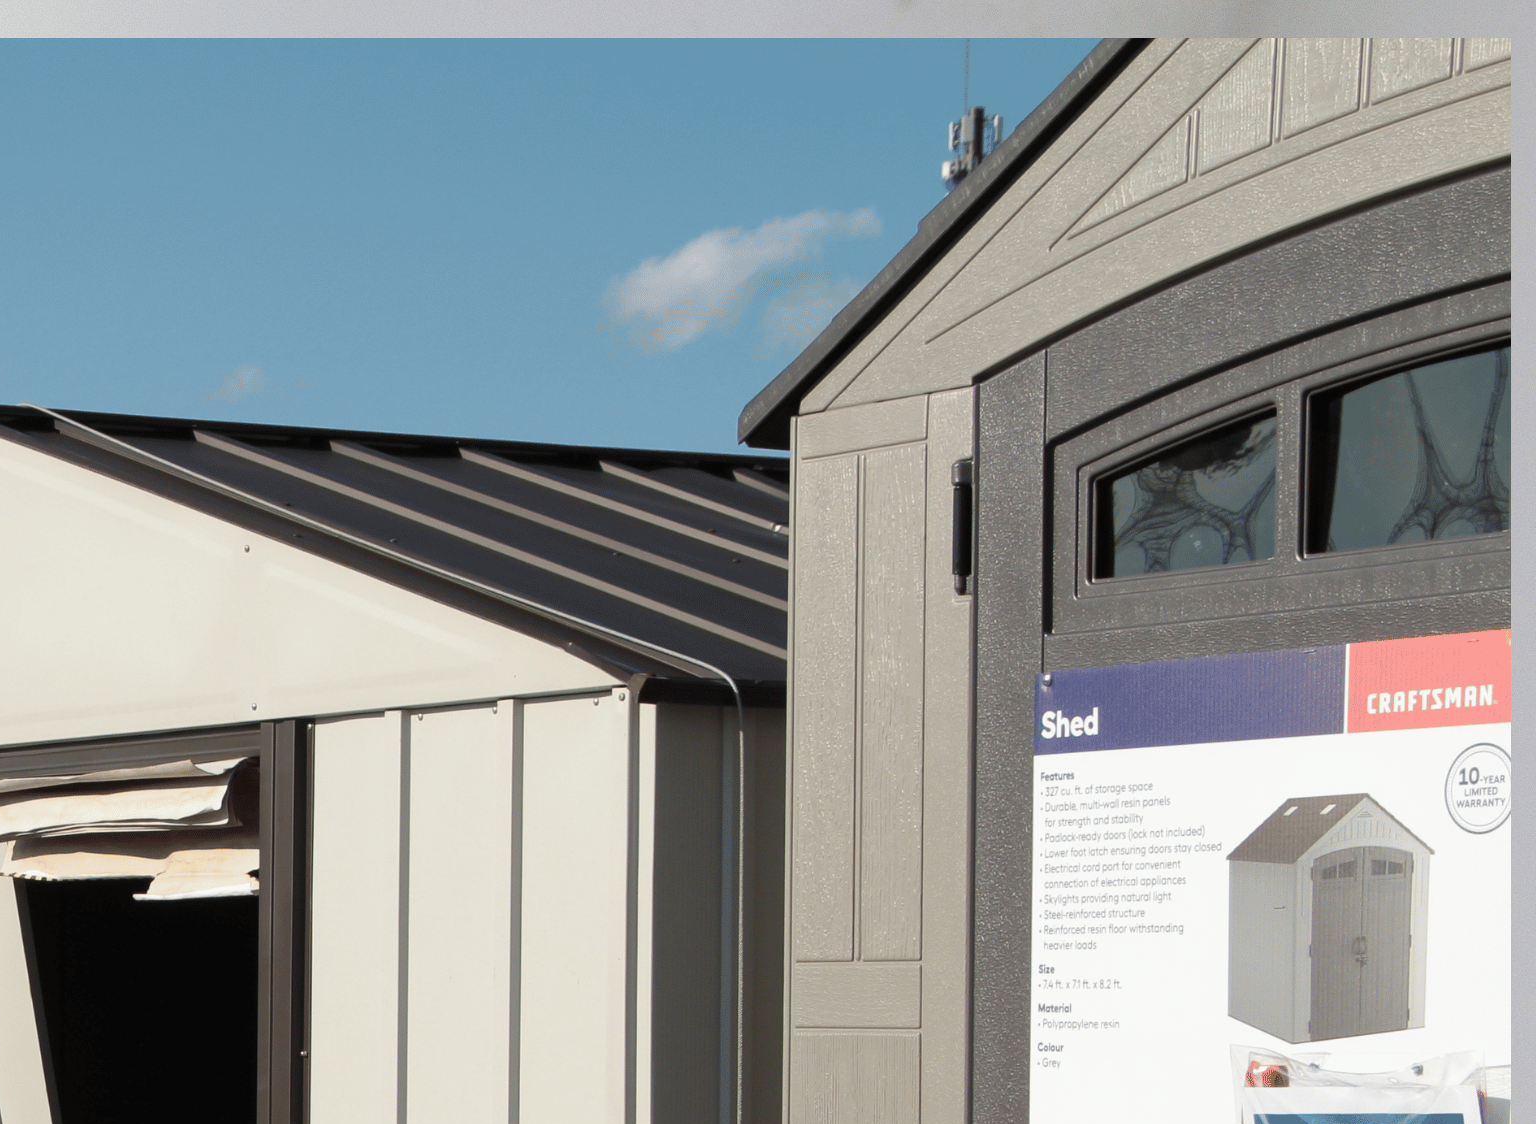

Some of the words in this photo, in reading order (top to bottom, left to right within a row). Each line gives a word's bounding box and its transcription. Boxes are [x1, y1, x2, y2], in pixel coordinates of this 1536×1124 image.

[1367, 684, 1494, 714] CRAFTSMAN
[1041, 707, 1100, 740] Shed
[1040, 772, 1074, 782] Features
[1045, 787, 1059, 797] 327
[1061, 788, 1073, 796] cu.
[1075, 785, 1083, 795] ft.
[1085, 785, 1094, 794] of
[1095, 784, 1126, 795] storage
[1128, 782, 1153, 793] space
[1464, 787, 1498, 797] LIMITED
[1045, 800, 1078, 812] Durable,
[1080, 799, 1119, 810] multi-wall
[1121, 798, 1140, 808] resin
[1142, 796, 1170, 808] panels
[1457, 798, 1506, 808] WARRANTY
[1045, 818, 1056, 827] for
[1058, 816, 1091, 828] strength
[1093, 815, 1109, 825] and
[1112, 813, 1143, 824] stability
[1045, 831, 1101, 843] Padlock-ready
[1103, 830, 1126, 840] doors
[1128, 828, 1147, 841] (lock
[1150, 827, 1164, 838] not
[1166, 825, 1205, 837] included)
[1045, 848, 1068, 858] Lower
[1071, 847, 1086, 857] foot
[1088, 846, 1108, 856] latch
[1111, 844, 1146, 856] ensuring
[1149, 843, 1172, 853] doors
[1174, 842, 1192, 854] stay
[1194, 842, 1222, 852] closed
[1045, 863, 1080, 874] Electrical
[1082, 861, 1100, 872] cord
[1102, 860, 1119, 873] port
[1122, 860, 1133, 870] for
[1135, 859, 1181, 870] convenient
[1044, 878, 1088, 889] connection
[1091, 878, 1099, 887] of
[1101, 876, 1138, 887] electrical
[1140, 875, 1186, 887] appliances
[1044, 894, 1079, 906] Skylights
[1081, 893, 1119, 904] providing
[1121, 892, 1151, 902] natural
[1153, 891, 1171, 903] light
[1044, 909, 1106, 920] Steel-reinforced
[1108, 908, 1145, 918] structure
[1044, 924, 1086, 935] Reinforced
[1088, 924, 1106, 933] resin
[1108, 923, 1127, 933] floor
[1129, 923, 1184, 934] withstanding
[1044, 940, 1073, 950] heavier
[1075, 940, 1097, 949] loads
[1038, 964, 1055, 974] Size
[1099, 979, 1112, 989] 8.2
[1038, 1003, 1072, 1013] Material
[1042, 1019, 1098, 1030] Polypropylene
[1100, 1019, 1119, 1028] resin
[1038, 1042, 1064, 1052] Colour
[1042, 1058, 1061, 1068] Grey
